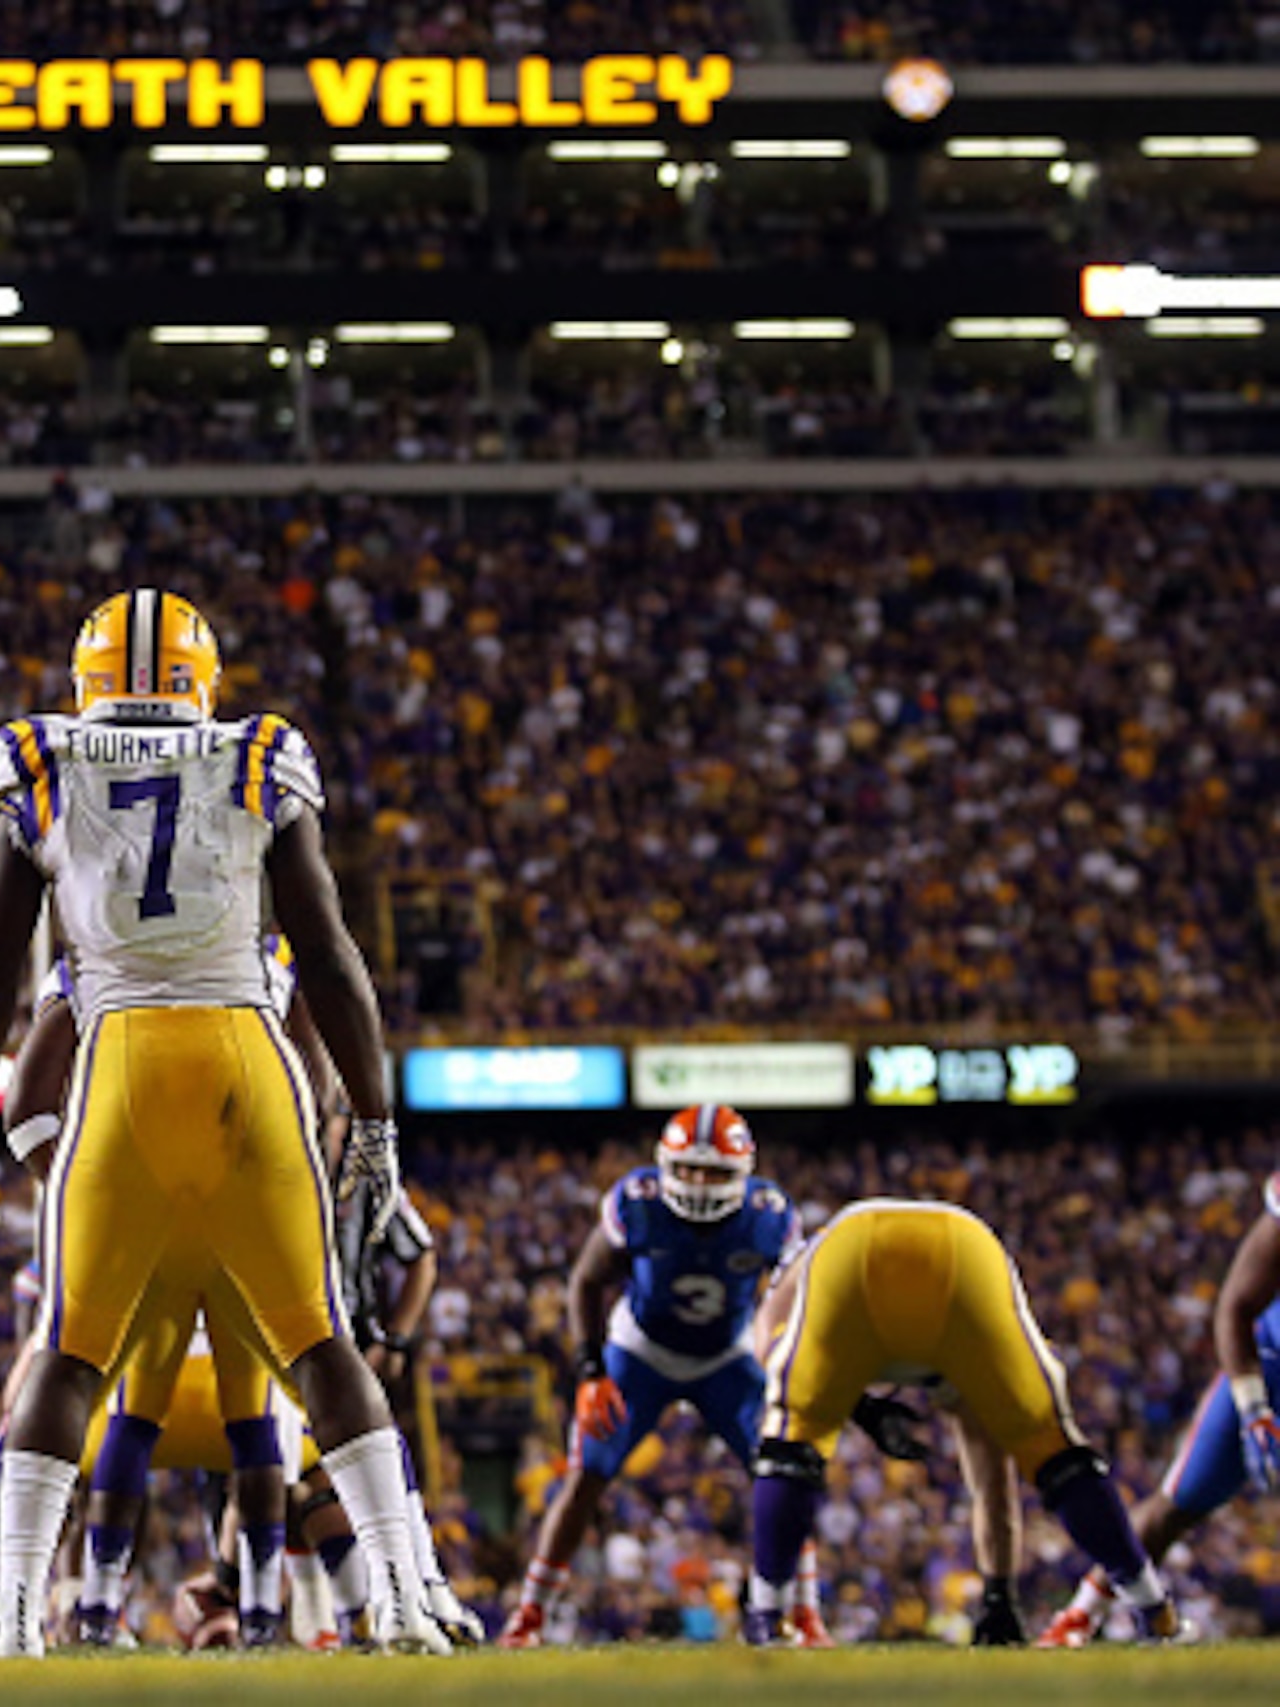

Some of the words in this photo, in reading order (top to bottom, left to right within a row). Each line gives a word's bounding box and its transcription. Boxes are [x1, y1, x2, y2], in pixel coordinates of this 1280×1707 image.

[309, 56, 732, 126] VALLEY
[66, 729, 224, 763] FOURNETTE
[109, 774, 180, 921] 7
[671, 1274, 726, 1325] 3
